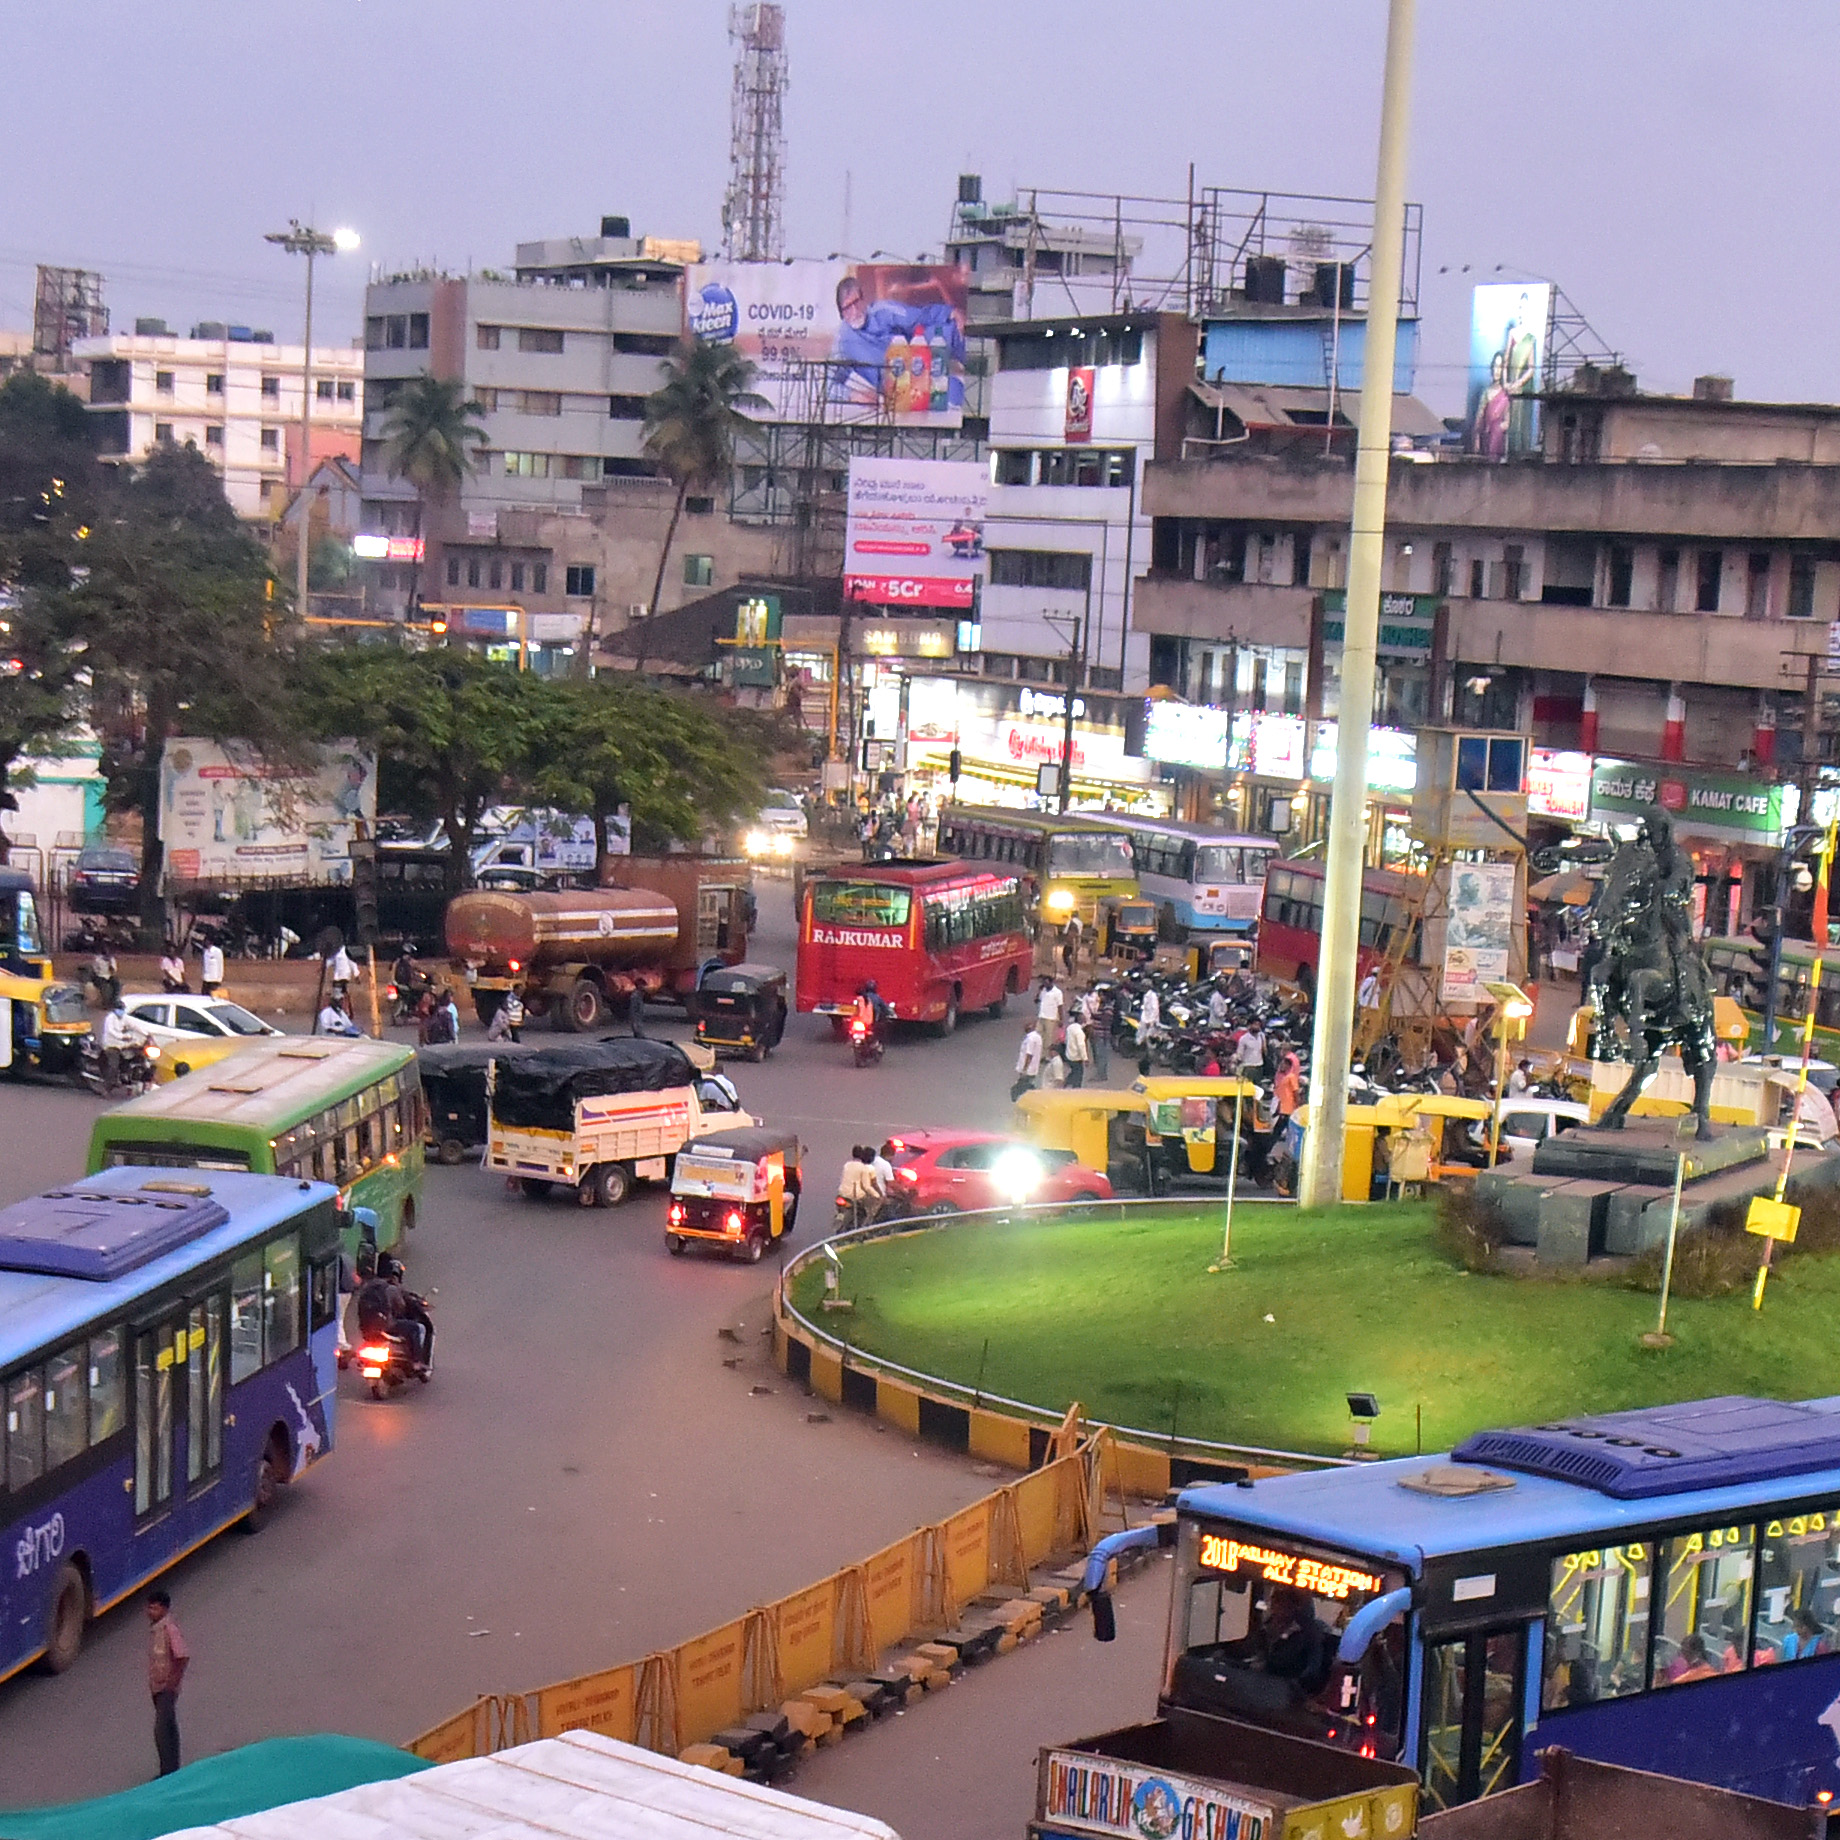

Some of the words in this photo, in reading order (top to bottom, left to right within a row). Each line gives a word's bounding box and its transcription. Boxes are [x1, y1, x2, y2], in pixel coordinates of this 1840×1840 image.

[703, 301, 734, 317] Max
[748, 304, 815, 321] COVID-19
[1692, 789, 1732, 810] KAMAT
[1736, 795, 1768, 815] CAFE
[812, 929, 904, 949] RAJKUMAR
[1263, 1565, 1293, 1585] ALL
[1295, 1573, 1349, 1599] STOPS
[1298, 1558, 1373, 1591] STATION
